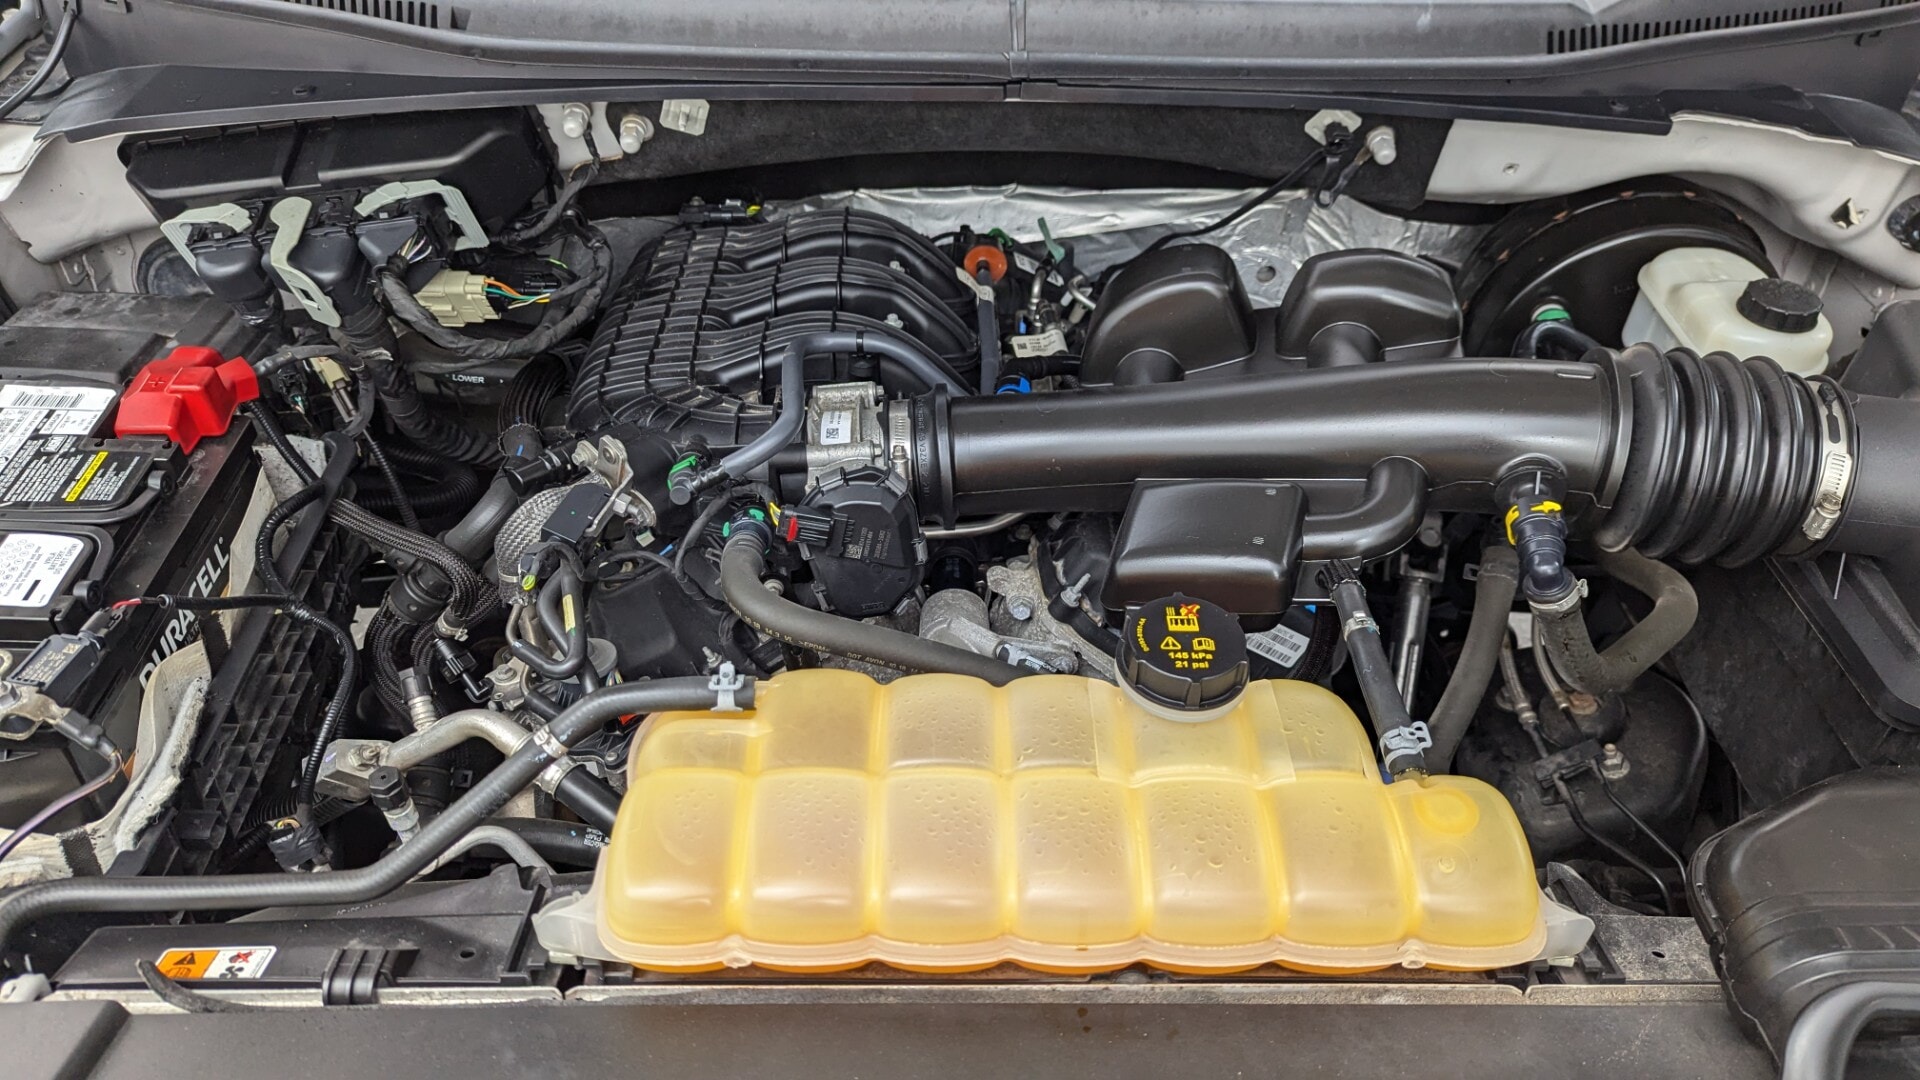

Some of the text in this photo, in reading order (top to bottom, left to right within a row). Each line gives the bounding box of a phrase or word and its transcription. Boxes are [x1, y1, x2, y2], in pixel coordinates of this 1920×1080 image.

[452, 373, 485, 384] LOWER
[1168, 651, 1213, 660] 145 kPa
[865, 657, 885, 666] AVON
[1175, 660, 1209, 670] 21 psi
